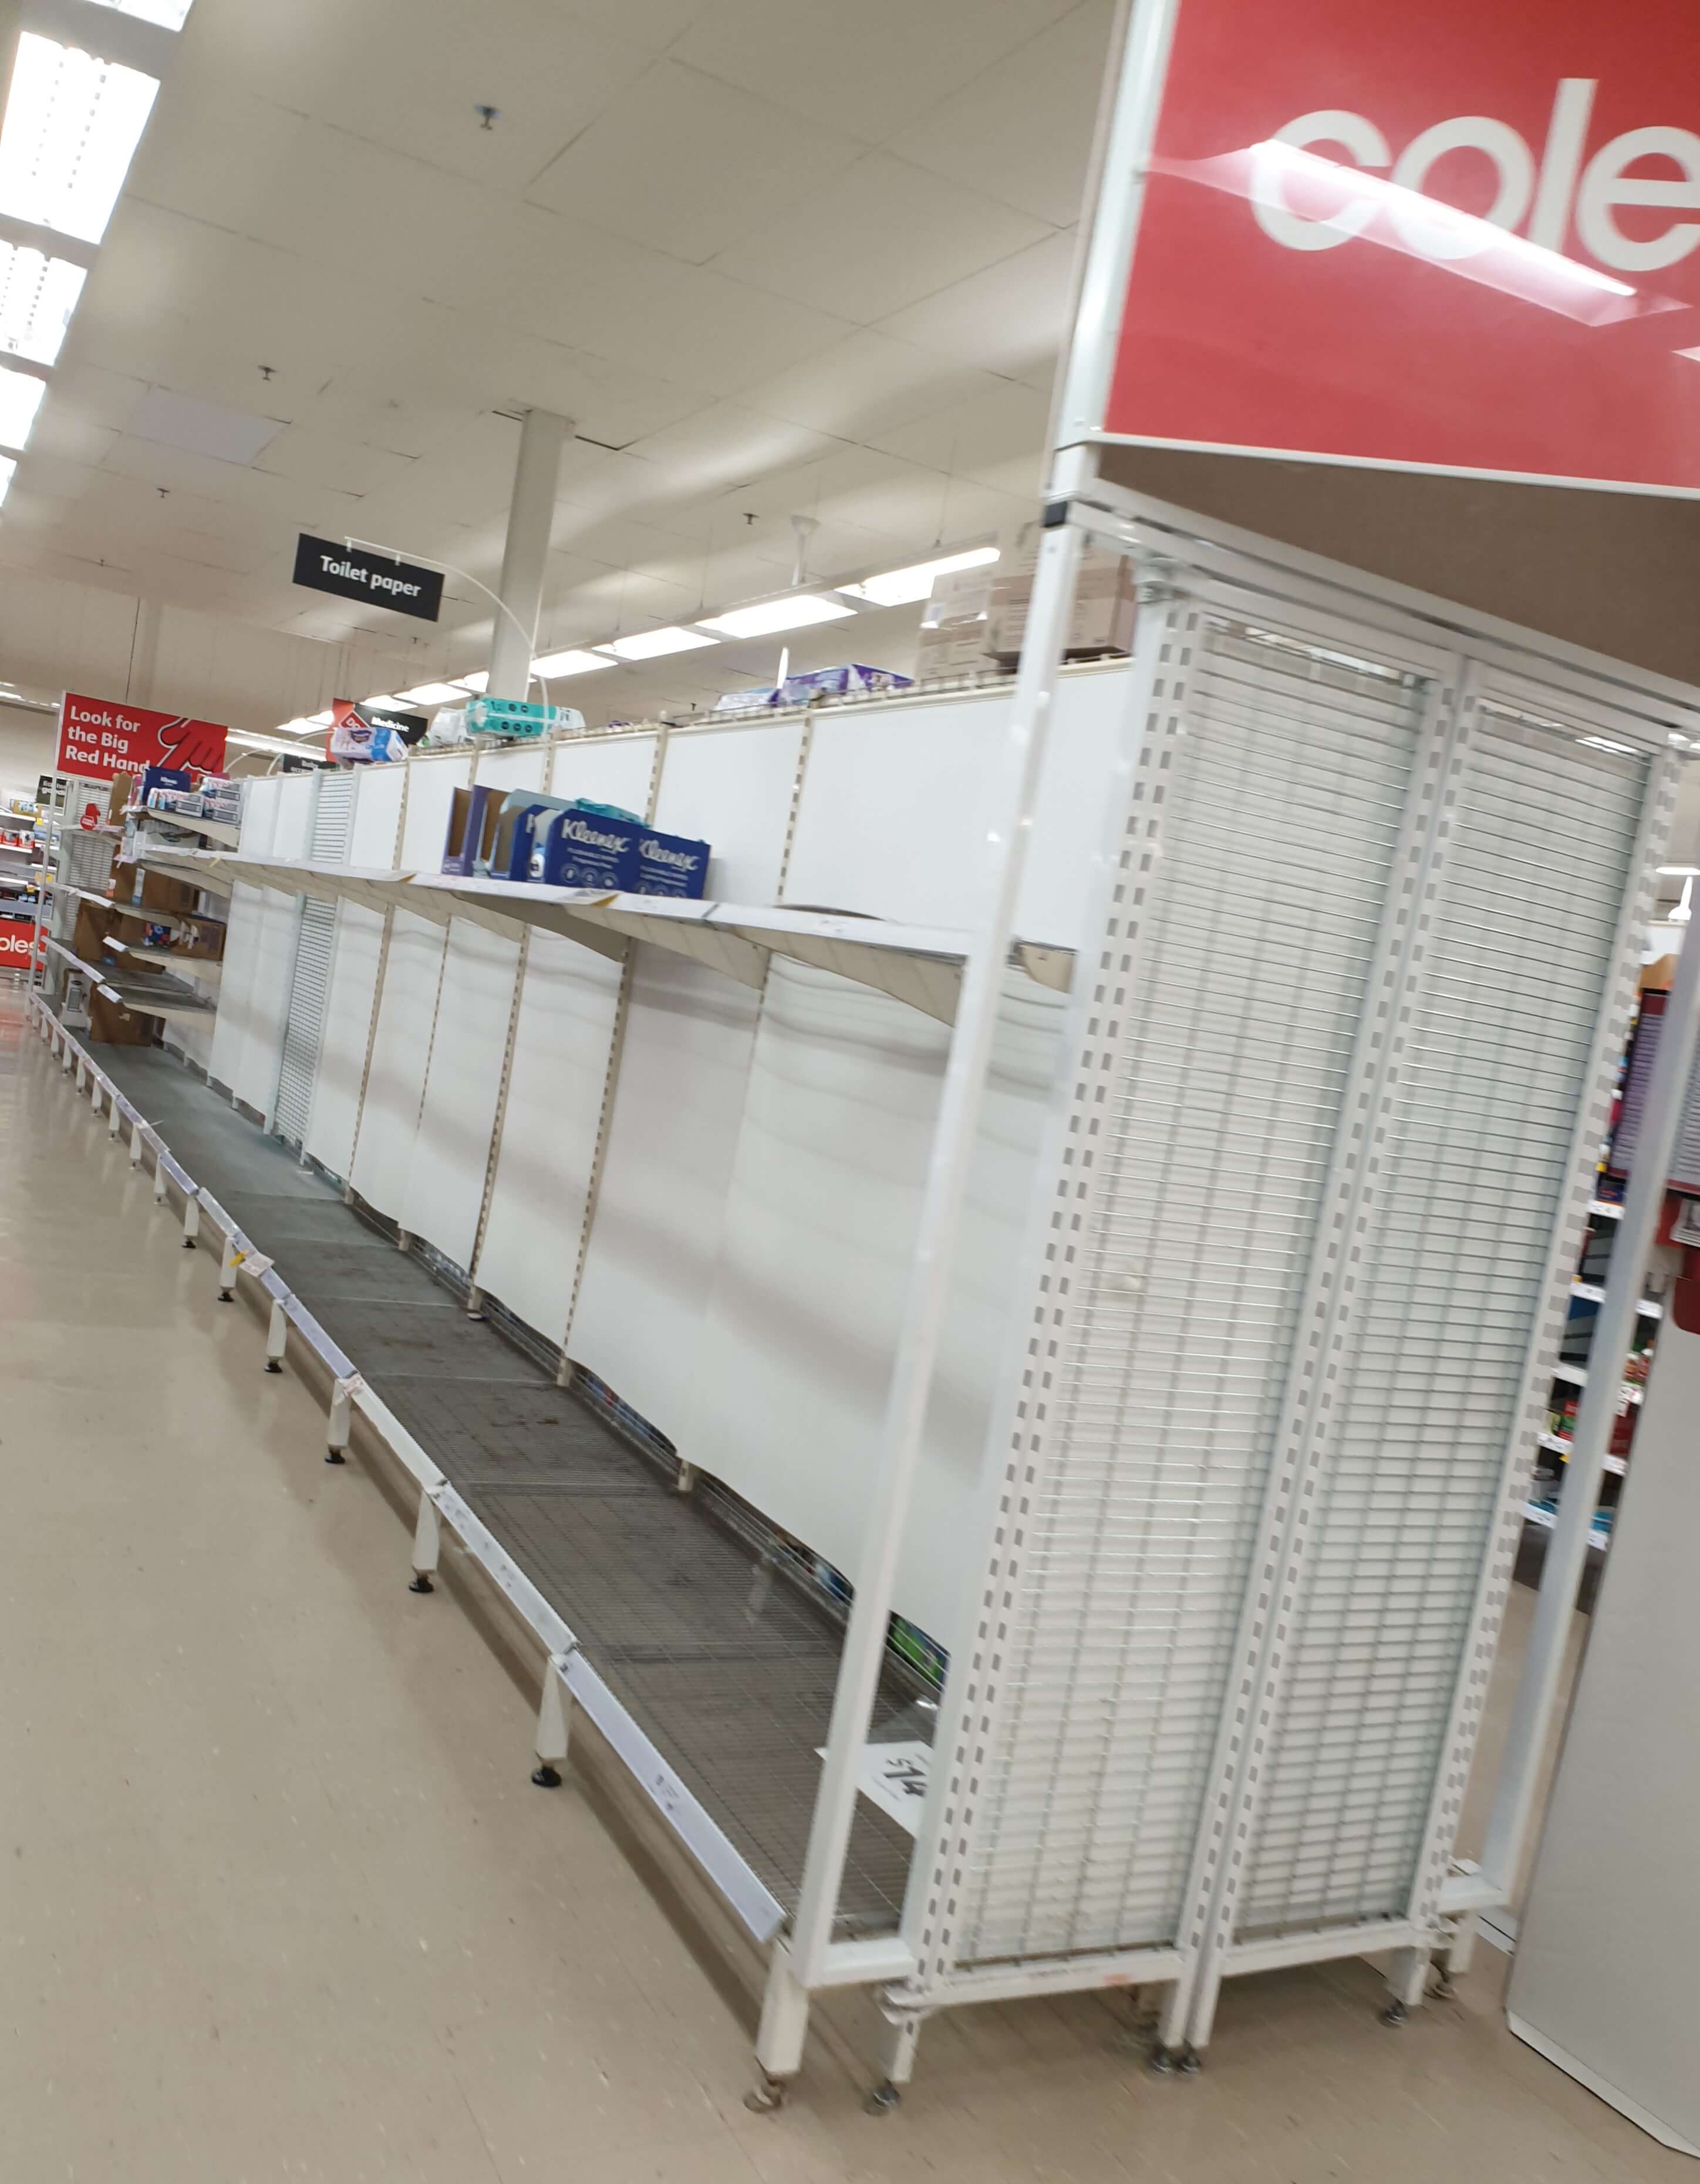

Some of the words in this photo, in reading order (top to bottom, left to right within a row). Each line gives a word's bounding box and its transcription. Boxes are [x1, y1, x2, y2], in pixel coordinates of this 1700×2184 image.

[1249, 78, 1700, 272] cole
[320, 555, 369, 583] Toilet
[370, 573, 422, 596] paper
[70, 706, 112, 727] Look
[116, 715, 141, 732] for
[371, 716, 410, 732] Medicine
[68, 725, 97, 744] the
[101, 732, 129, 754] Big
[66, 745, 99, 765] Red
[103, 752, 150, 774] Hand
[561, 818, 632, 853] Kleenex
